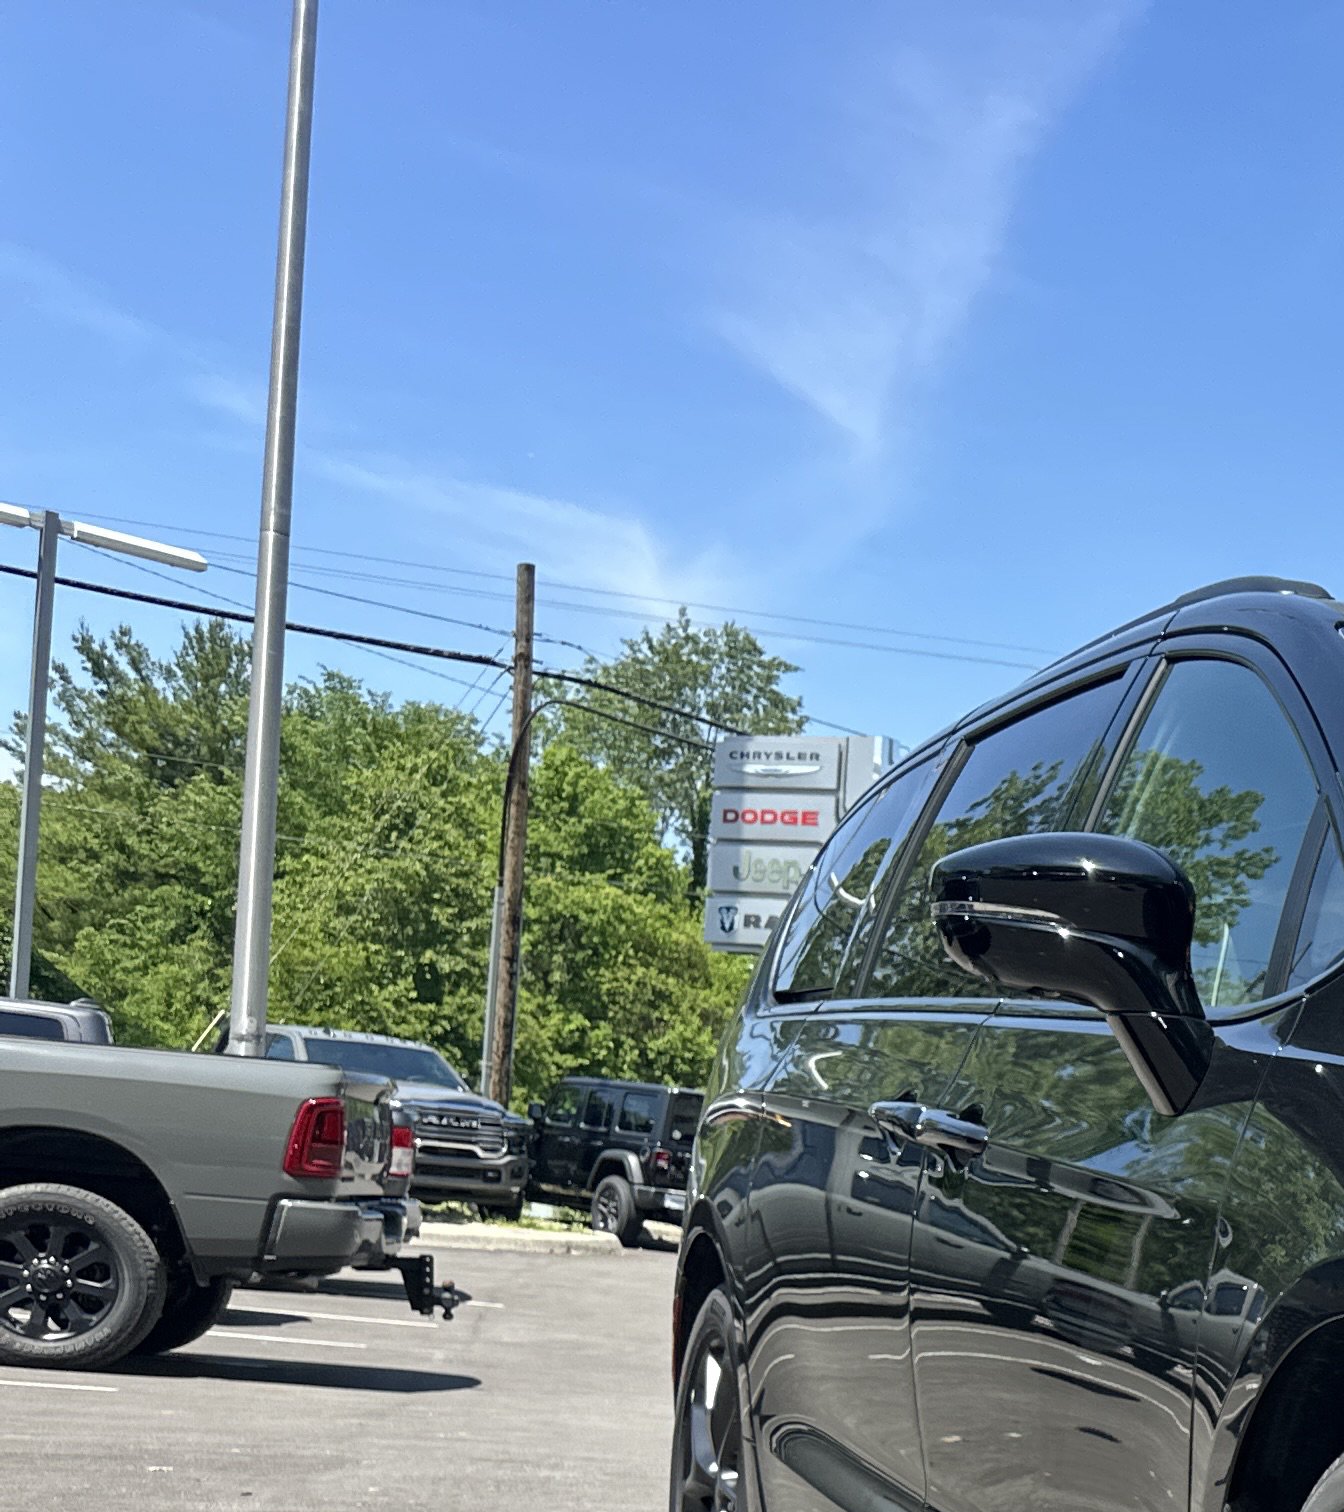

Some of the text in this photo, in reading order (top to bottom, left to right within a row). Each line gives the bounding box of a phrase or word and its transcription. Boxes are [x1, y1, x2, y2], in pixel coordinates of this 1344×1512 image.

[728, 750, 821, 762] CHRYSLER
[722, 808, 819, 827] DODGE
[732, 850, 800, 889] Jeep
[743, 914, 780, 930] RA
